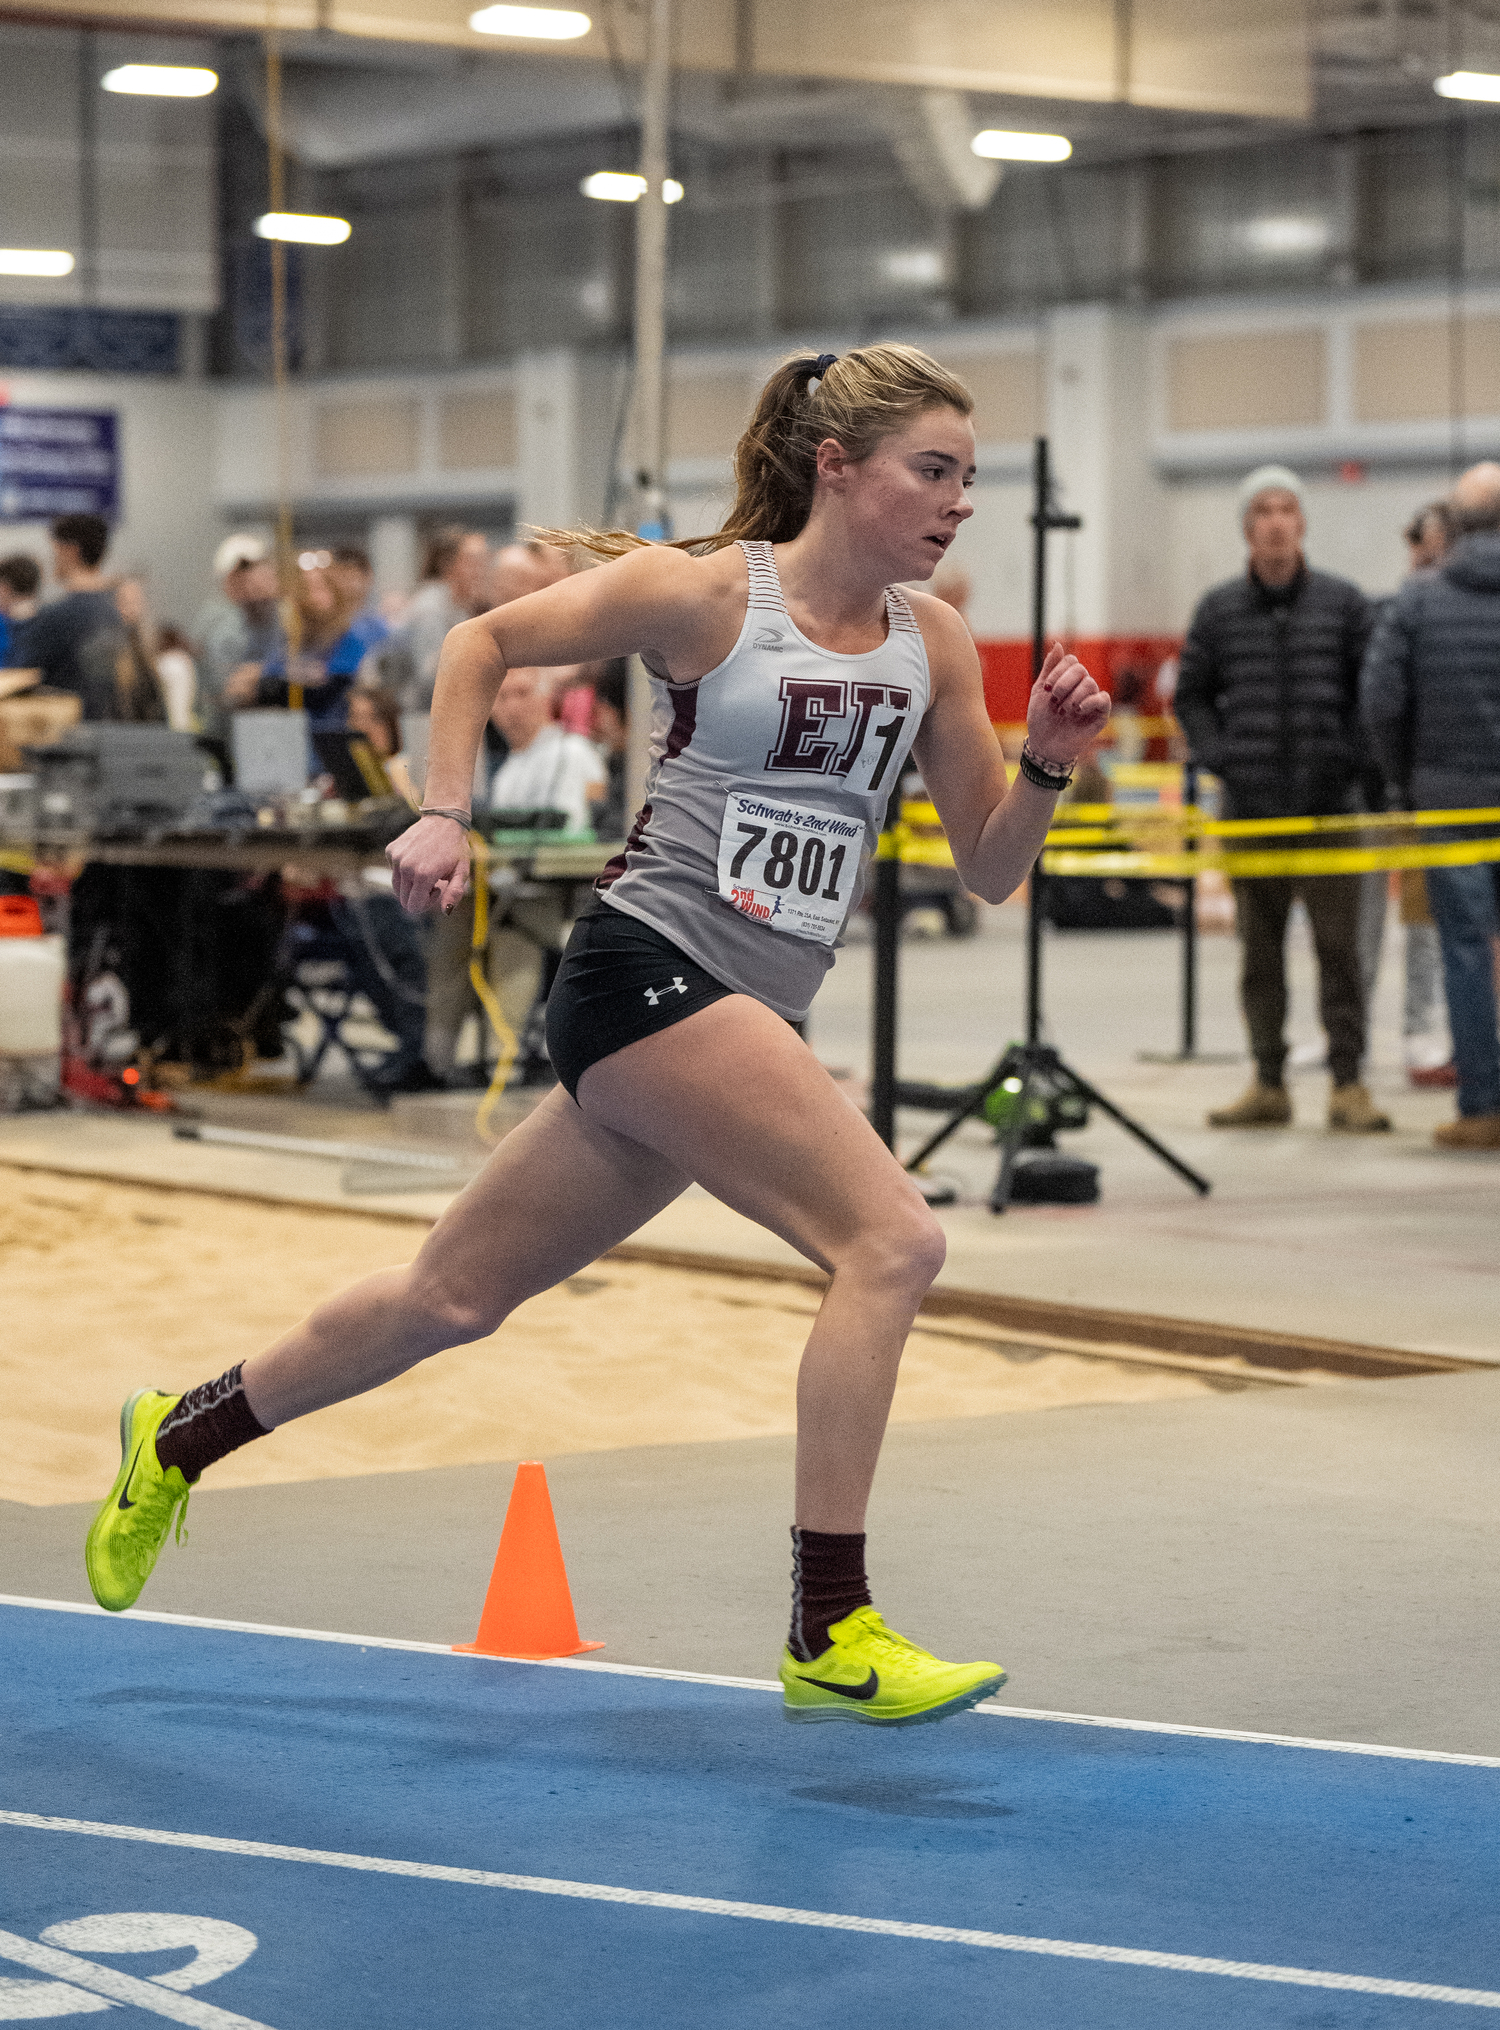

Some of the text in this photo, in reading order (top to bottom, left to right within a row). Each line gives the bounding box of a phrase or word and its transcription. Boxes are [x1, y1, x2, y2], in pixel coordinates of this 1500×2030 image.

[752, 642, 784, 653] DYNAMIC
[867, 715, 906, 791] 1
[737, 799, 859, 838] Schwab's 2nd Wind
[730, 822, 846, 902] 7801
[741, 900, 770, 919] WIND
